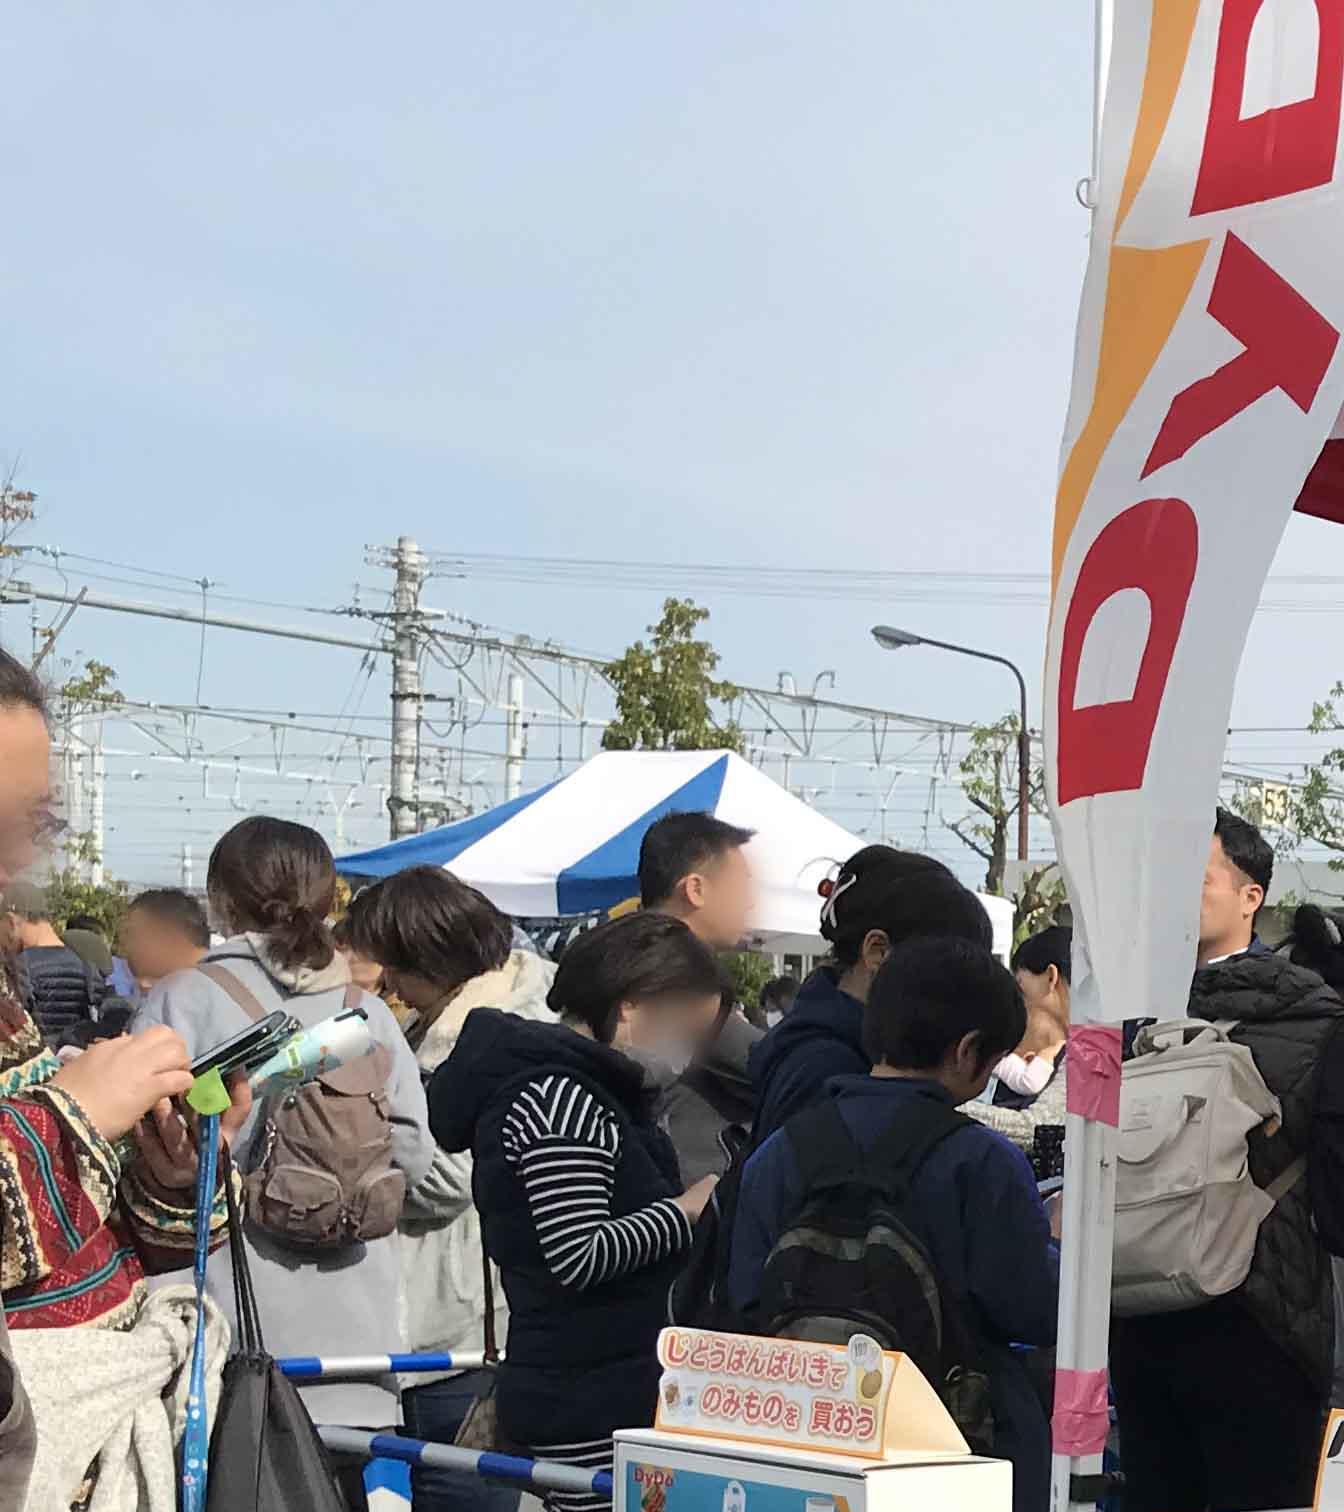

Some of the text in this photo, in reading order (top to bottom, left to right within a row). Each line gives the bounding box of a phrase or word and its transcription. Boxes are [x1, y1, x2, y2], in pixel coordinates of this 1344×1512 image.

[1264, 788, 1288, 824] 53
[701, 1386, 876, 1436] のみものを 買おう
[633, 1467, 675, 1488] DyDo
